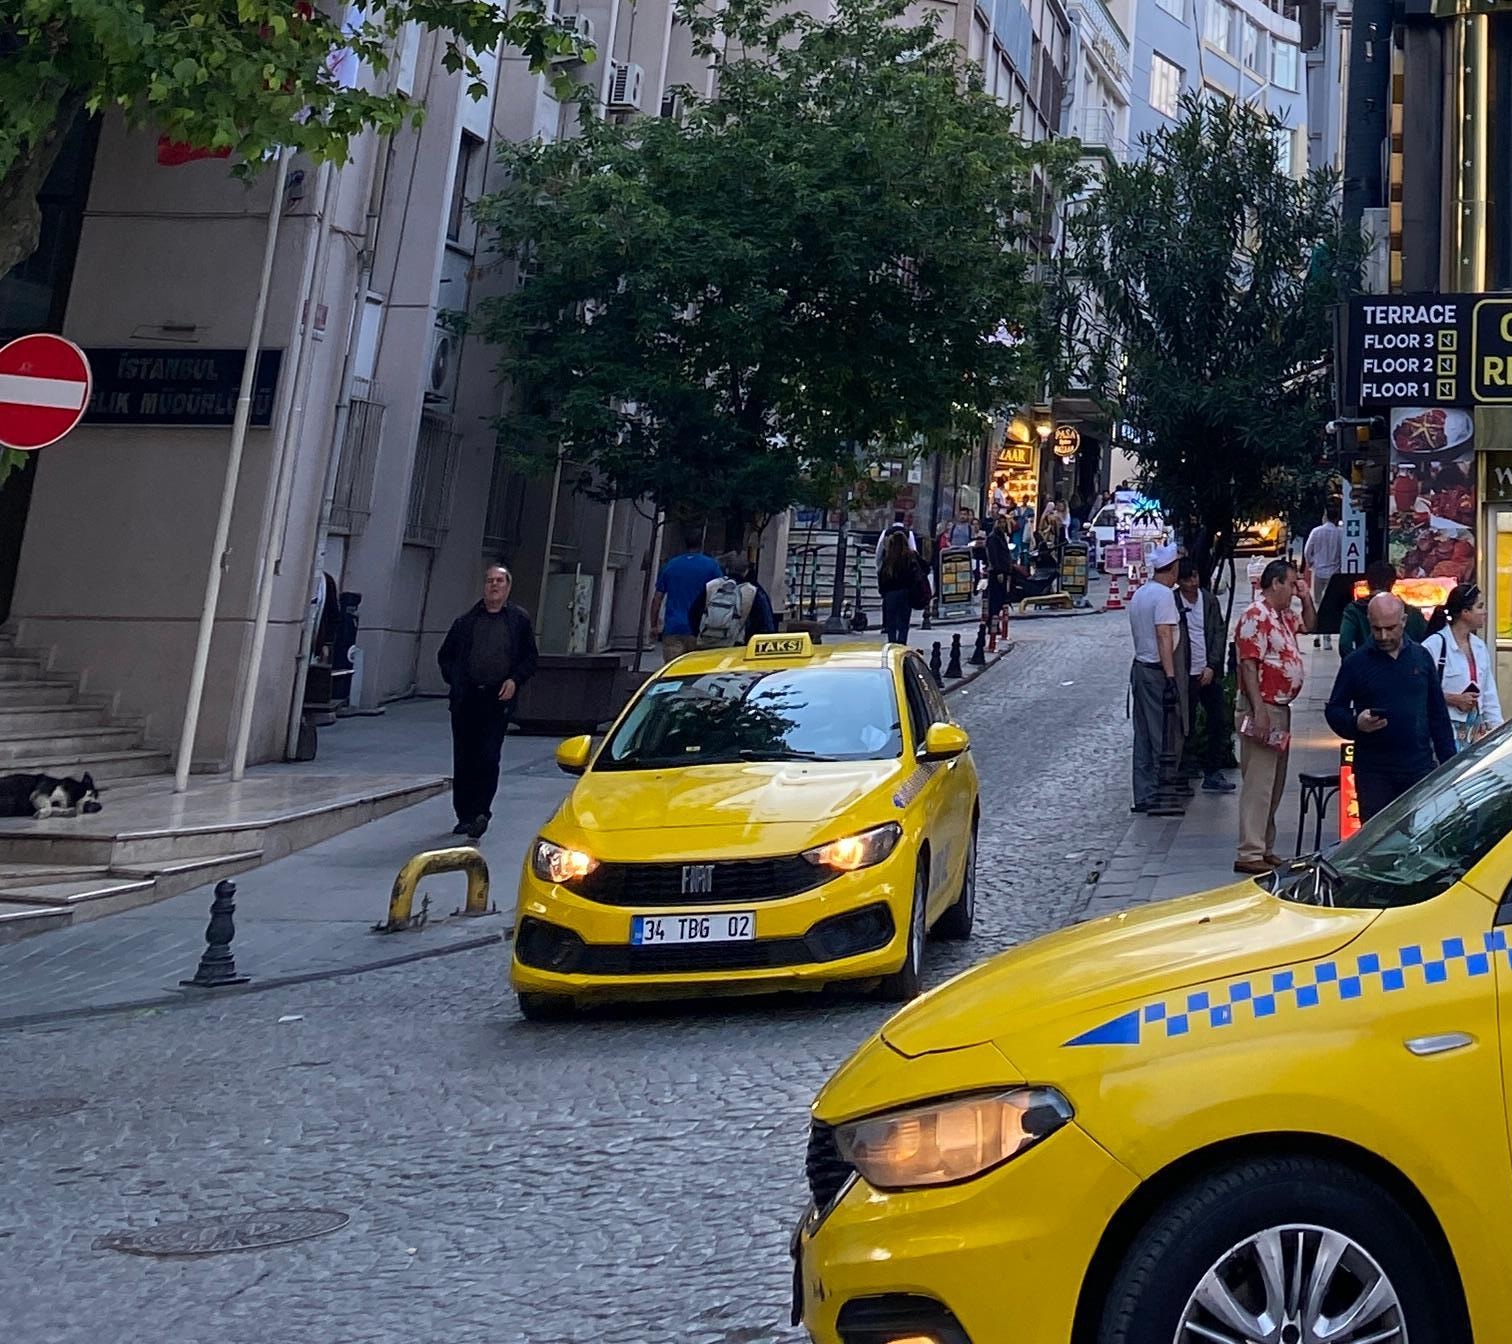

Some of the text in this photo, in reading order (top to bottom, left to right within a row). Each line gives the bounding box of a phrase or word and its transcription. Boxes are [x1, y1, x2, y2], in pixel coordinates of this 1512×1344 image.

[1363, 305, 1457, 325] TERRACE
[1364, 333, 1434, 350] FLOOR 3
[1363, 357, 1433, 374] FLOOR 2
[1362, 382, 1430, 398] FLOOR 1
[681, 865, 715, 893] FIAT
[645, 916, 749, 940] 34 TBG 02
